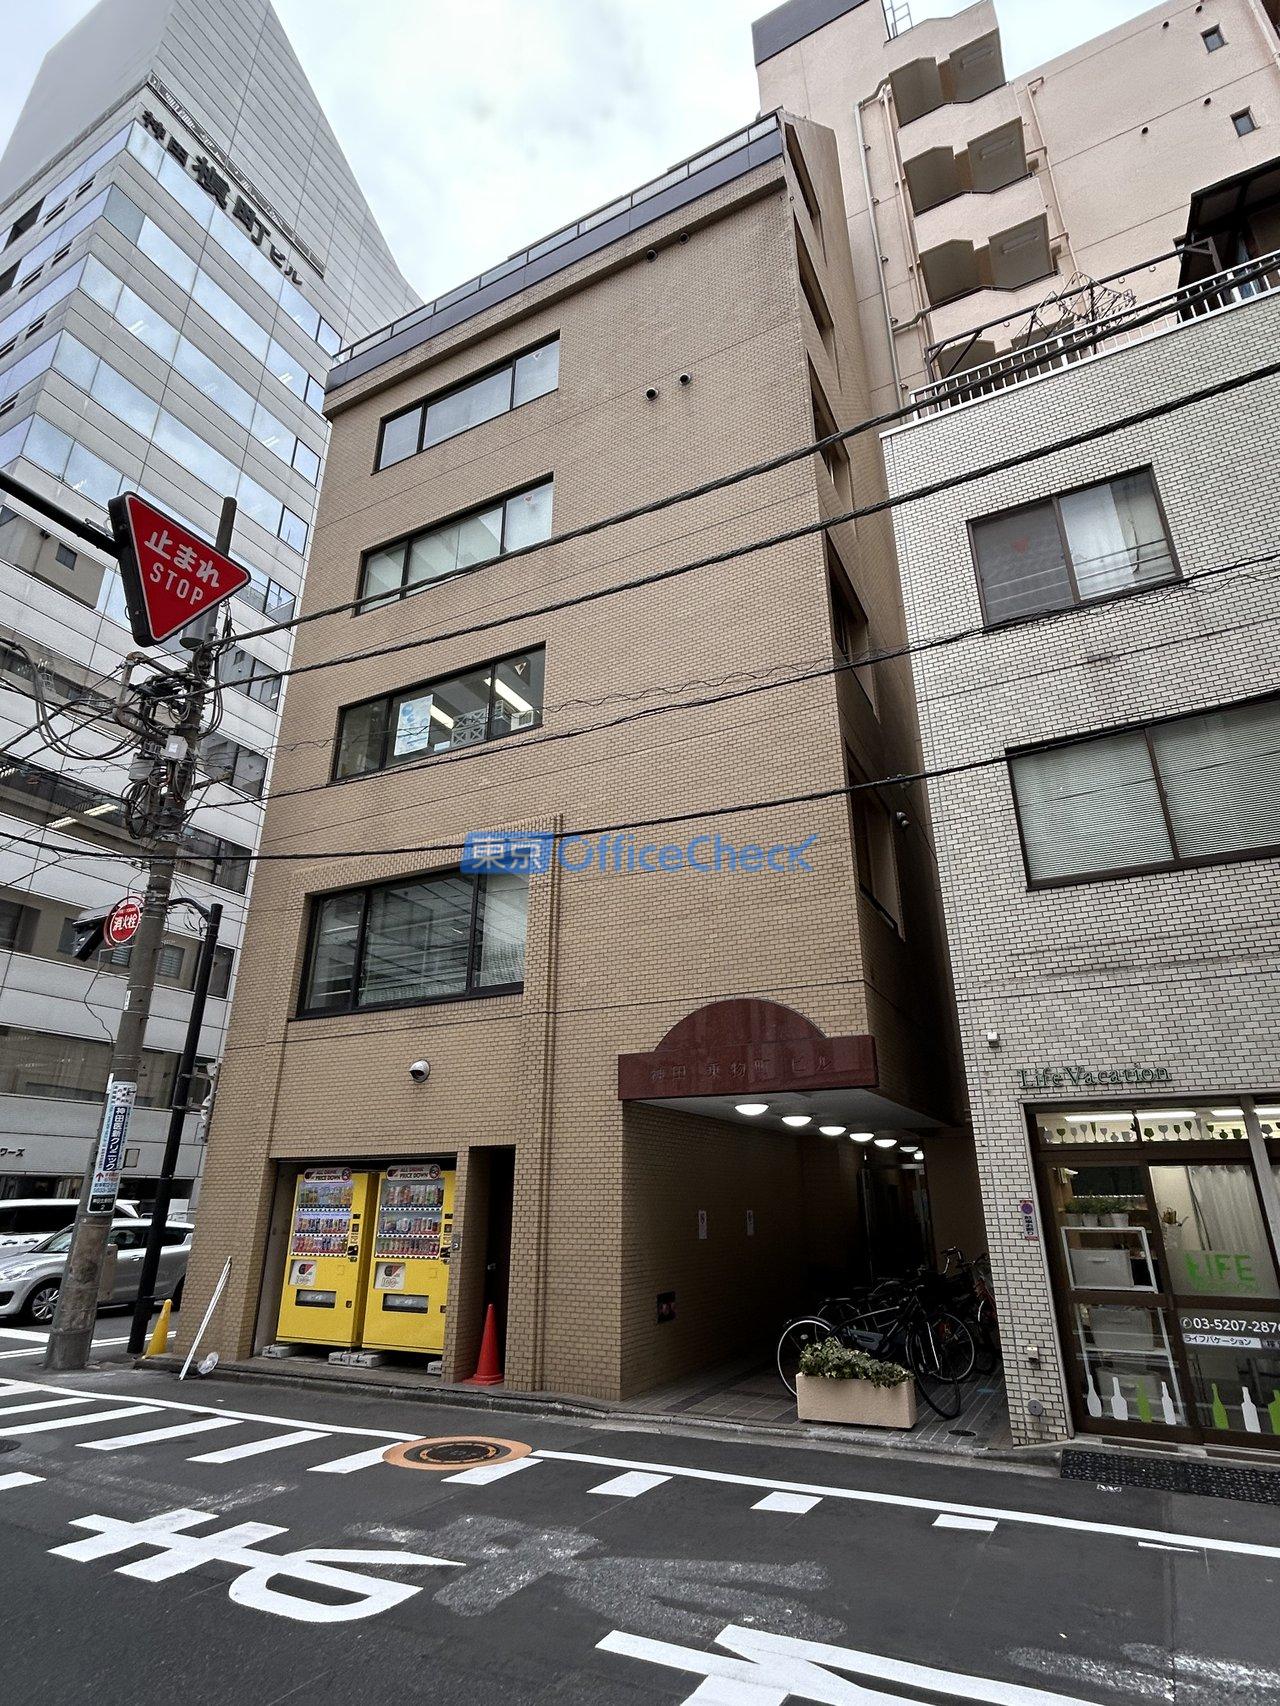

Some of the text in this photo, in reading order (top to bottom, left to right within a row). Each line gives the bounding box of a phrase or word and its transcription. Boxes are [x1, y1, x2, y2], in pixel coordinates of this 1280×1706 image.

[144, 529, 220, 588] 止まれ
[149, 561, 204, 605] STOP
[113, 913, 138, 931] 消火栓
[1193, 1317, 1280, 1334] 03-5207-287
